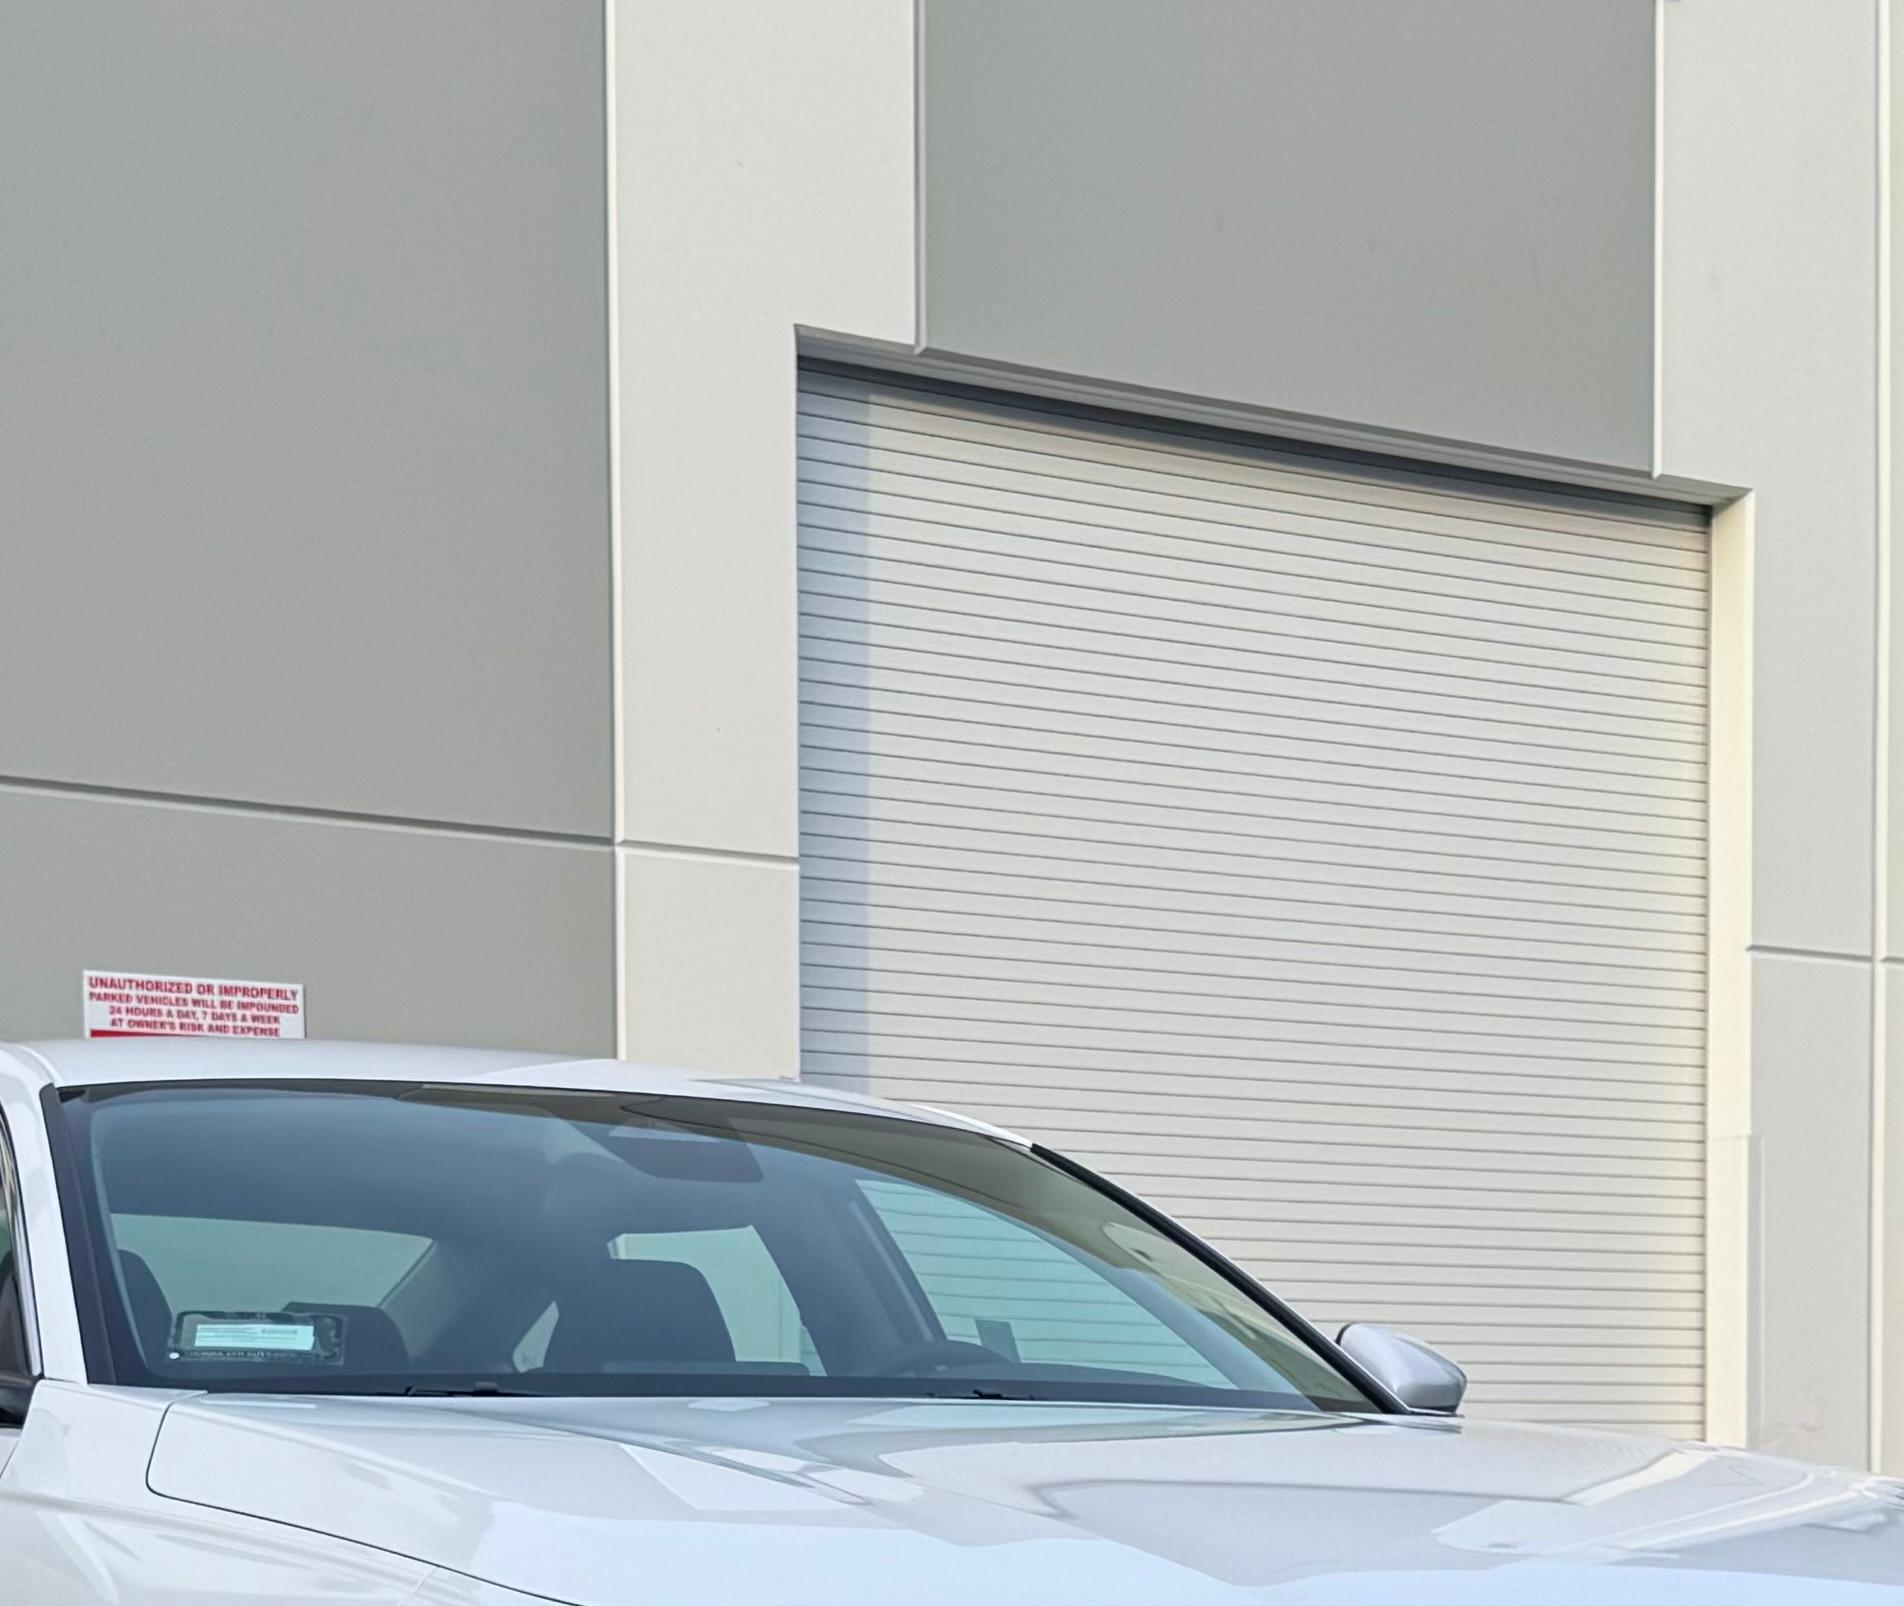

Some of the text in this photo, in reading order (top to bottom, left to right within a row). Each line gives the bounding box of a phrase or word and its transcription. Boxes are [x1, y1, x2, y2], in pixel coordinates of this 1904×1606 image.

[89, 976, 299, 1001] UNAUTHORIZED OR IMPROPERLY
[89, 991, 300, 1014] PARKED VEHICLES WILL BE IMPOUNDED
[109, 1005, 280, 1025] 24 HOURS A DAY, 7 DAYS A WEEK
[111, 1018, 280, 1037] AT OWNER'S RISK AND EXPENSE
